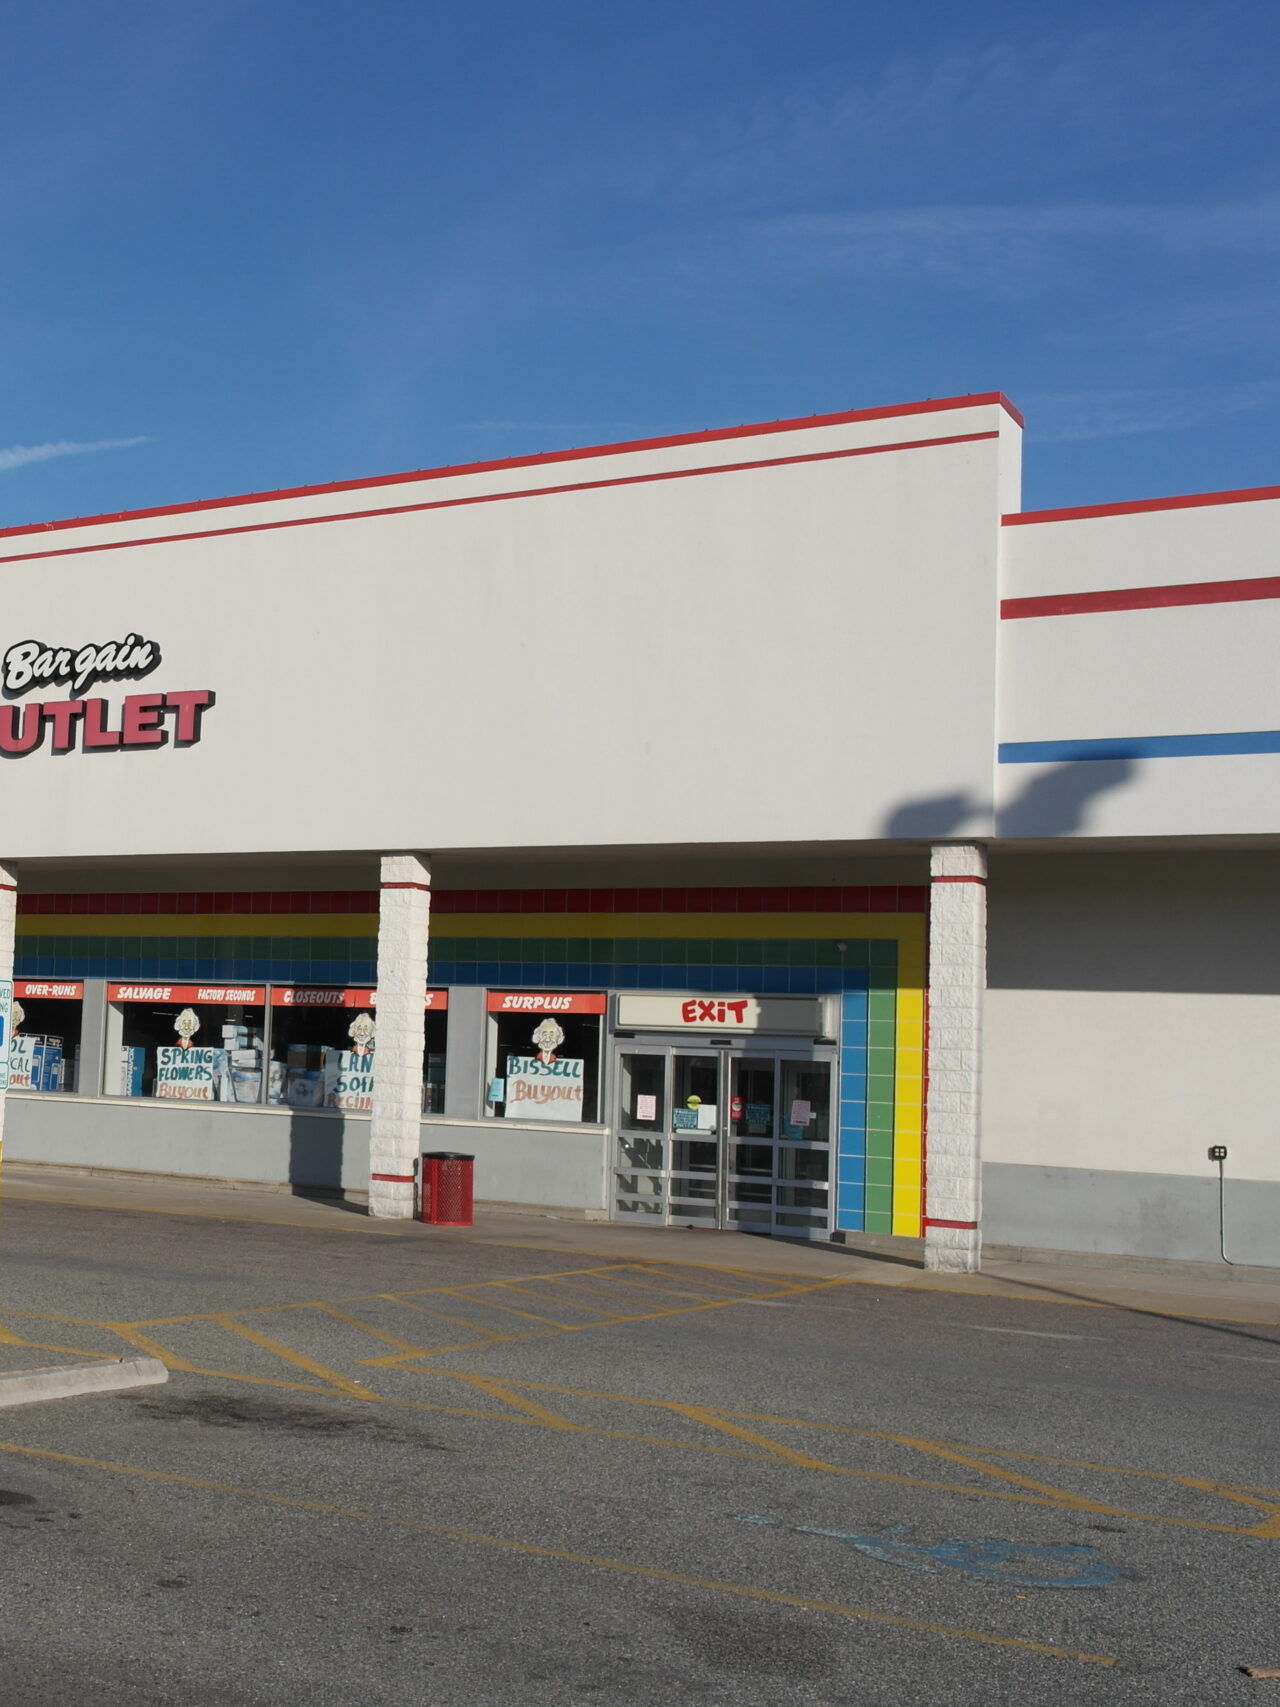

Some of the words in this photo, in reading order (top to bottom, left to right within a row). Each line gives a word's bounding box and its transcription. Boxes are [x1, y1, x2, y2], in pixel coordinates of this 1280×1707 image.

[3, 633, 160, 696] Bargain
[24, 984, 76, 996] OVER-RUNS
[117, 986, 172, 1000] SALVAGE
[197, 989, 225, 1001] FACTORY
[225, 990, 255, 1002] SECONDS
[283, 991, 345, 1004] CLOSEOUTS
[502, 995, 572, 1010] SURPLUS
[11, 1056, 29, 1073] CAL
[161, 1048, 213, 1065] SPRING
[159, 1082, 208, 1099] Buyout
[510, 1079, 584, 1104] Buyout
